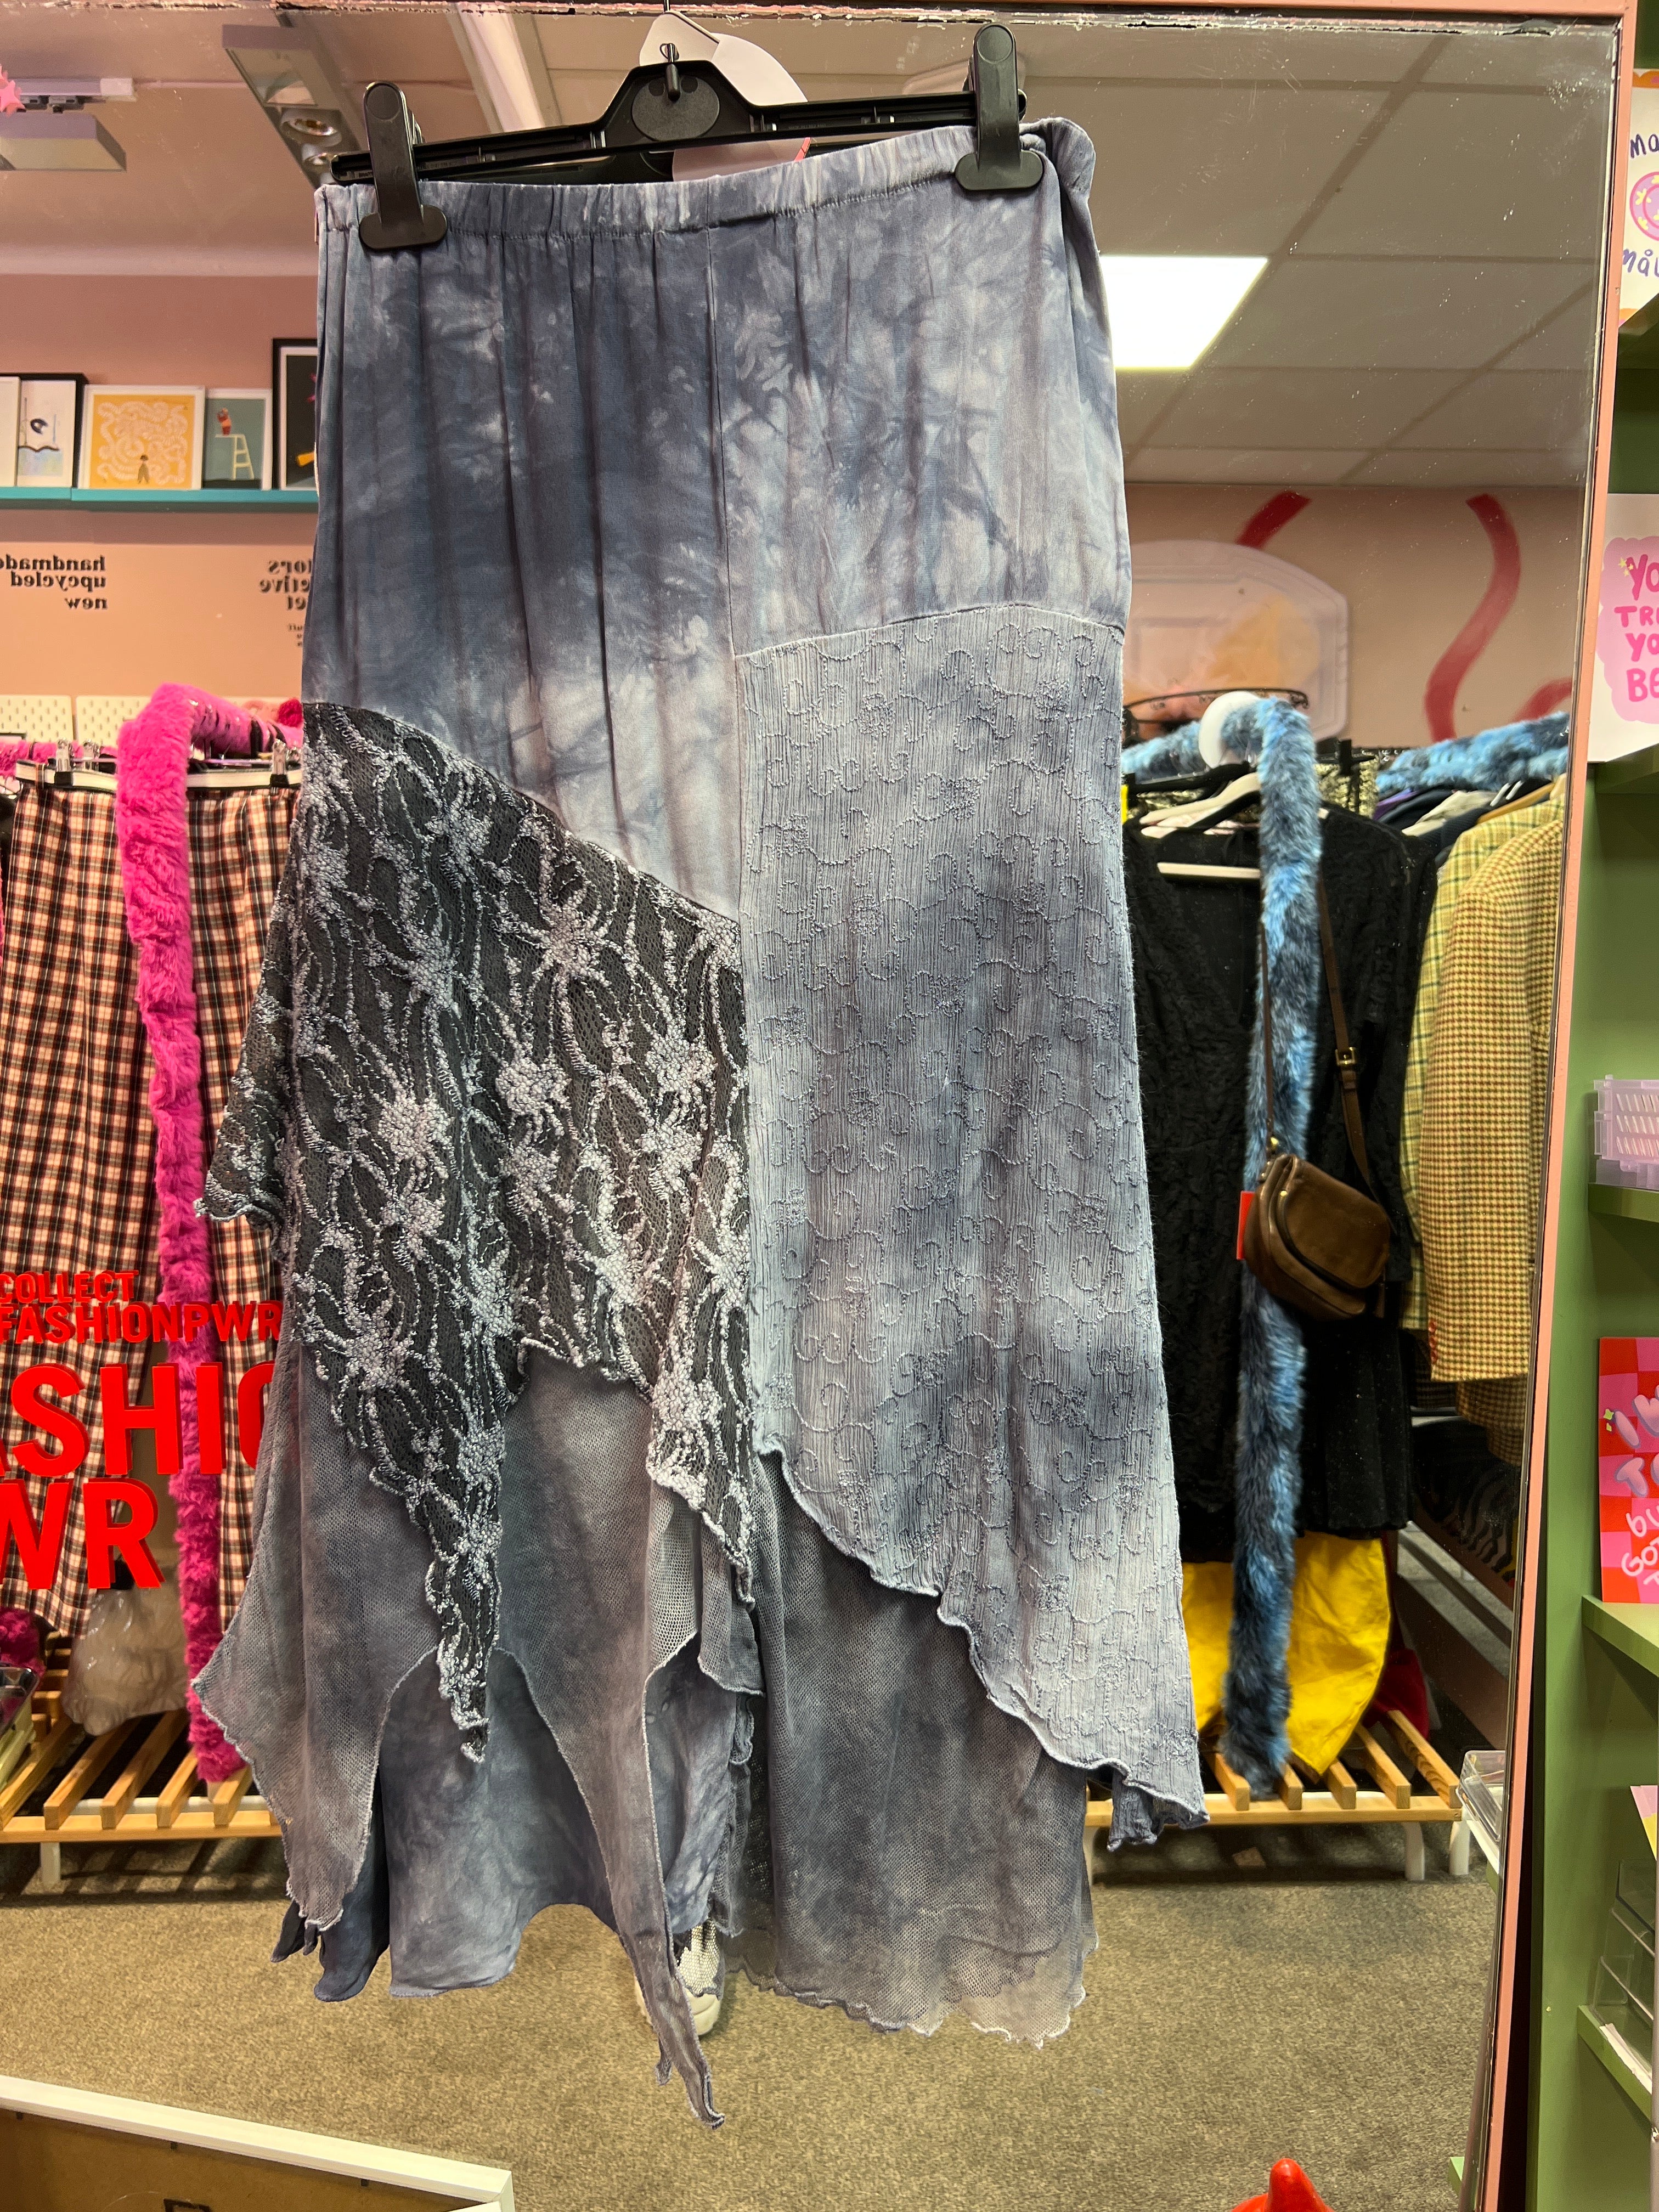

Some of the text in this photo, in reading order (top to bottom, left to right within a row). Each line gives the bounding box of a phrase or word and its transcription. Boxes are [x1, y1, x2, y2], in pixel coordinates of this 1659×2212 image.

[1614, 606, 1659, 627] TR
[0, 1272, 136, 1304] COLLECT
[0, 1302, 283, 1344] FASHIONPWR
[0, 1363, 275, 1477] SHI
